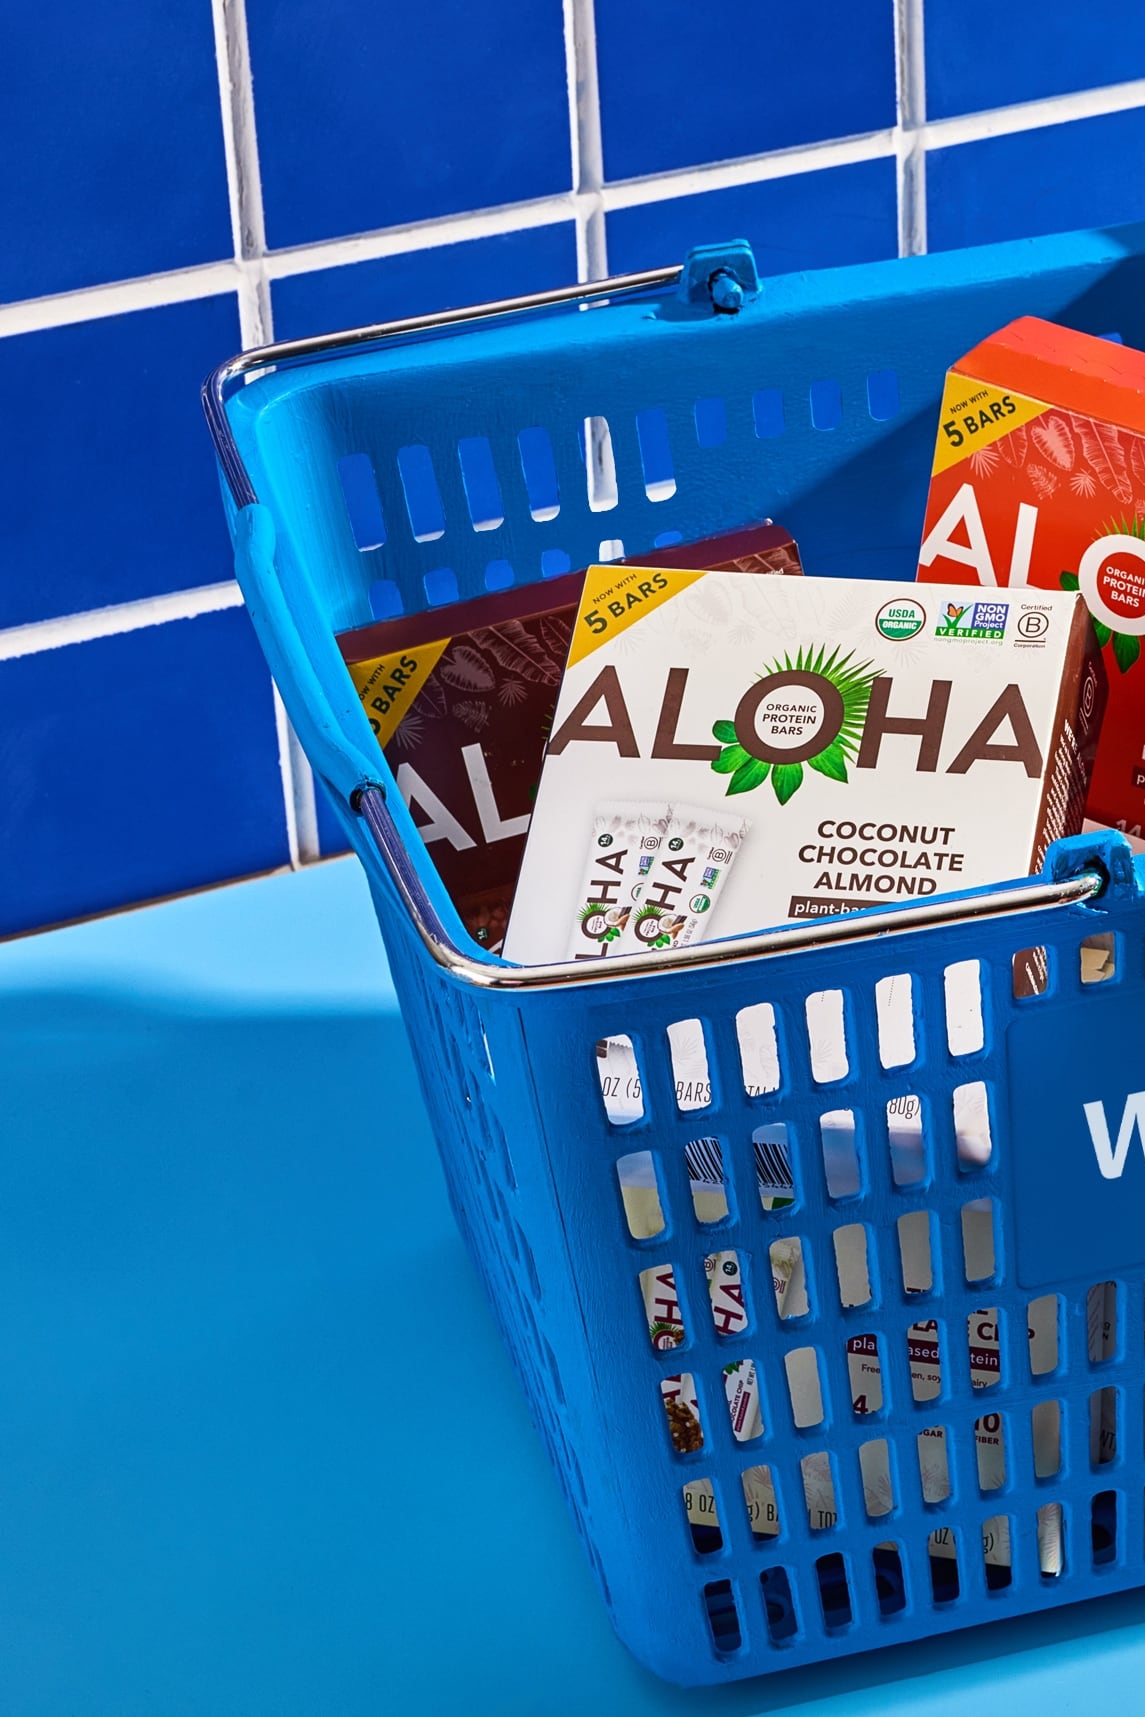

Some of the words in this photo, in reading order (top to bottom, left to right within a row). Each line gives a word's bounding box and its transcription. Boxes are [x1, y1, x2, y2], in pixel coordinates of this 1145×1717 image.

[950, 400, 968, 414] NOW
[969, 390, 989, 404] WITH
[943, 420, 964, 447] 5
[963, 395, 1016, 434] BARS
[593, 588, 613, 604] NOW
[615, 574, 637, 590] WITH
[584, 610, 608, 634] 5
[608, 573, 668, 618] BARS
[1111, 590, 1139, 607] BARS
[888, 609, 915, 618] USDA
[977, 604, 1006, 613] NON
[1020, 604, 1052, 612] Certified
[882, 620, 917, 630] ORGANIC
[974, 620, 1004, 629] Project
[975, 612, 1006, 622] GMO
[1025, 617, 1041, 633] B
[939, 628, 1002, 638] VERIFIED
[934, 637, 1003, 646] nongmoproject.org
[368, 664, 385, 685] WITH
[371, 655, 417, 714] BARS
[766, 704, 817, 712] ORGANIC
[547, 665, 1043, 778] ALOHA
[762, 714, 816, 724] PROTEIN
[771, 725, 803, 735] BARS
[817, 820, 955, 845] COCONUT
[798, 844, 964, 872] CHOCOLATE
[813, 871, 937, 896] ALMOND
[794, 901, 866, 915] plant-ba
[677, 1081, 711, 1102] BARS
